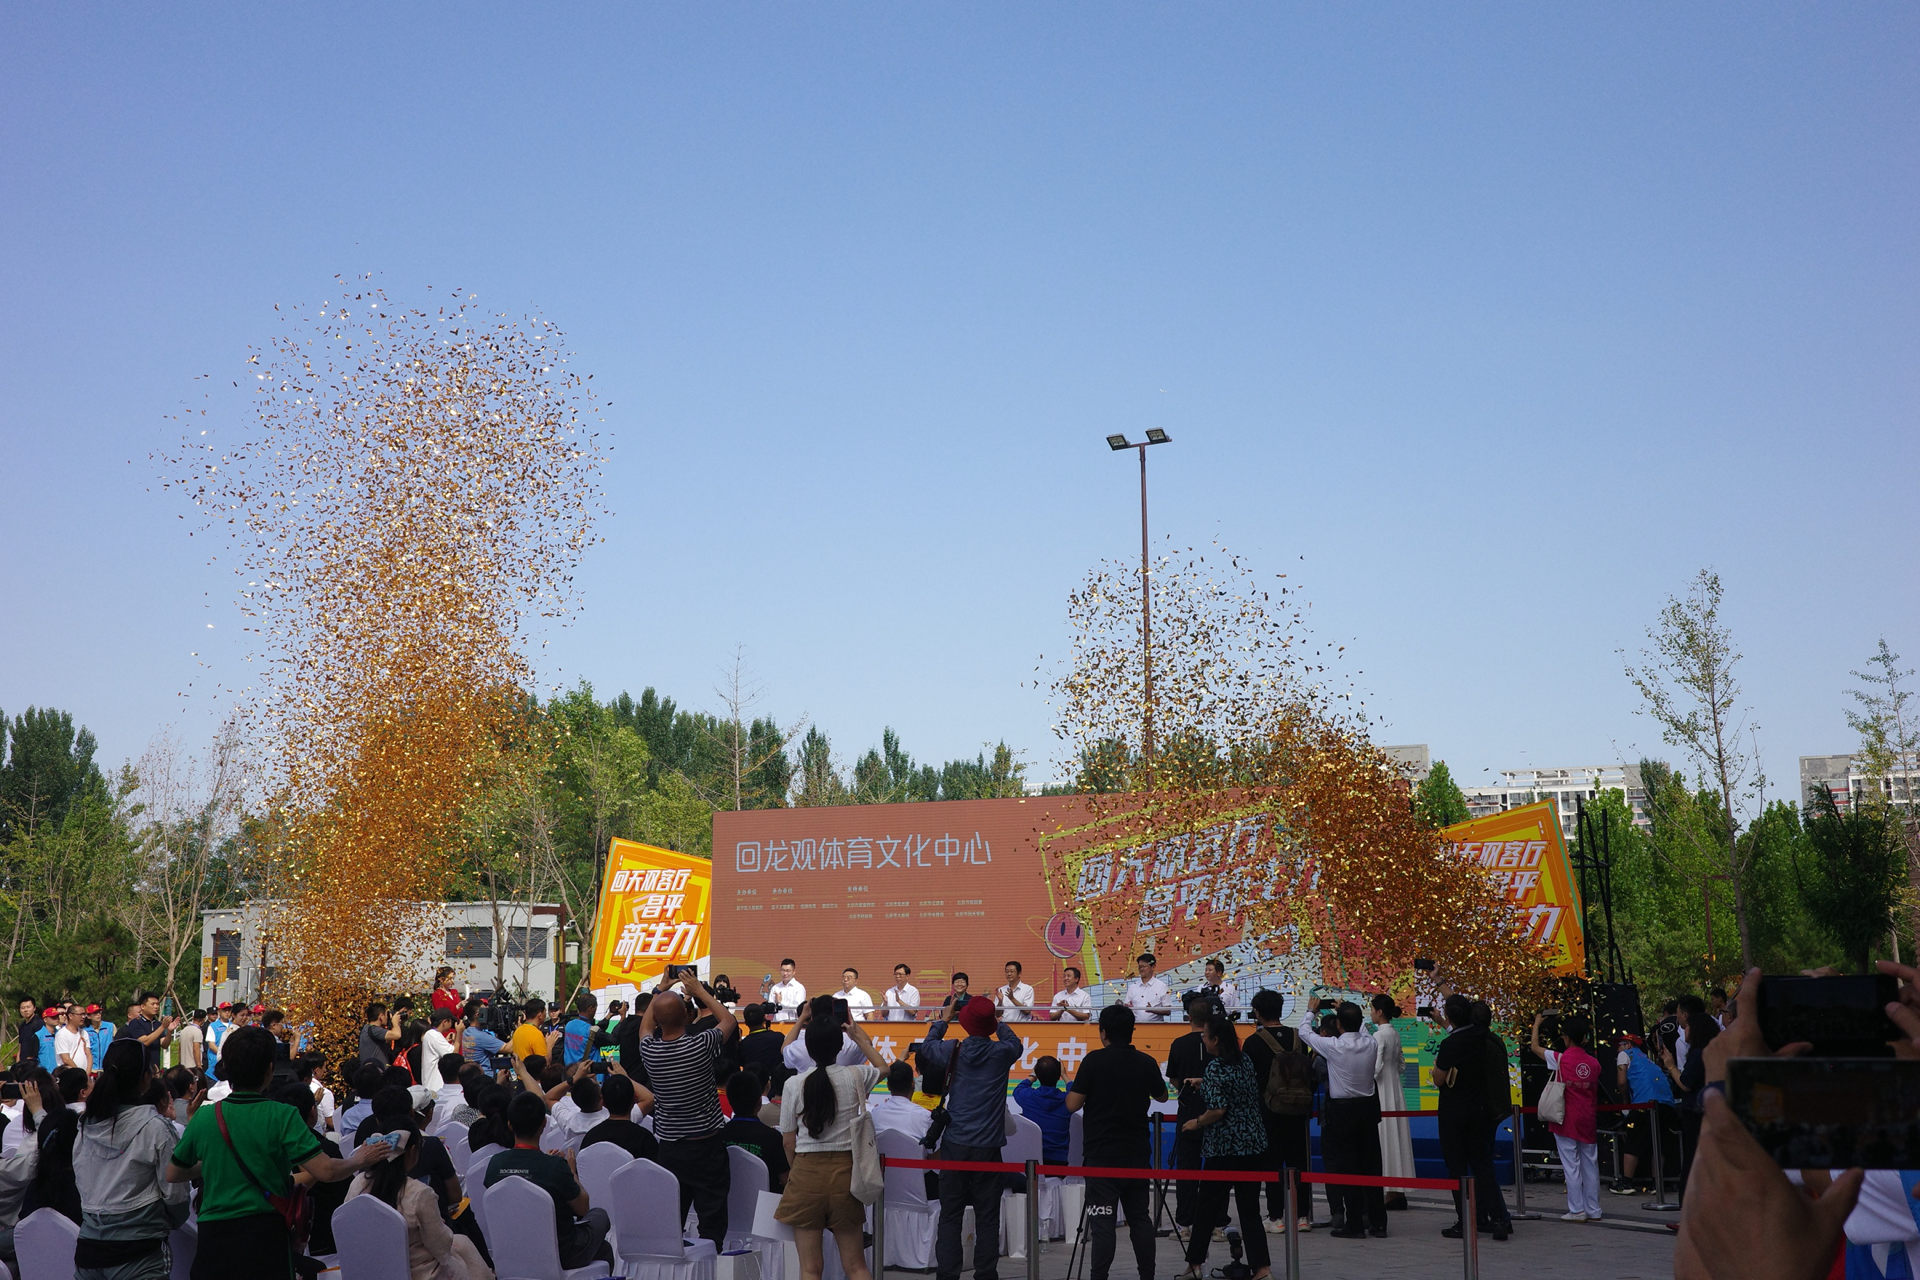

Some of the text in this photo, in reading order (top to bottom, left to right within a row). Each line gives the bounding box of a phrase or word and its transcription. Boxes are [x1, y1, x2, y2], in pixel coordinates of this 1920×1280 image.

[735, 830, 993, 873] 回龙观体育文化中心
[847, 884, 869, 893] 支持单位
[641, 894, 686, 919] 昌平
[614, 921, 698, 968] 新生力
